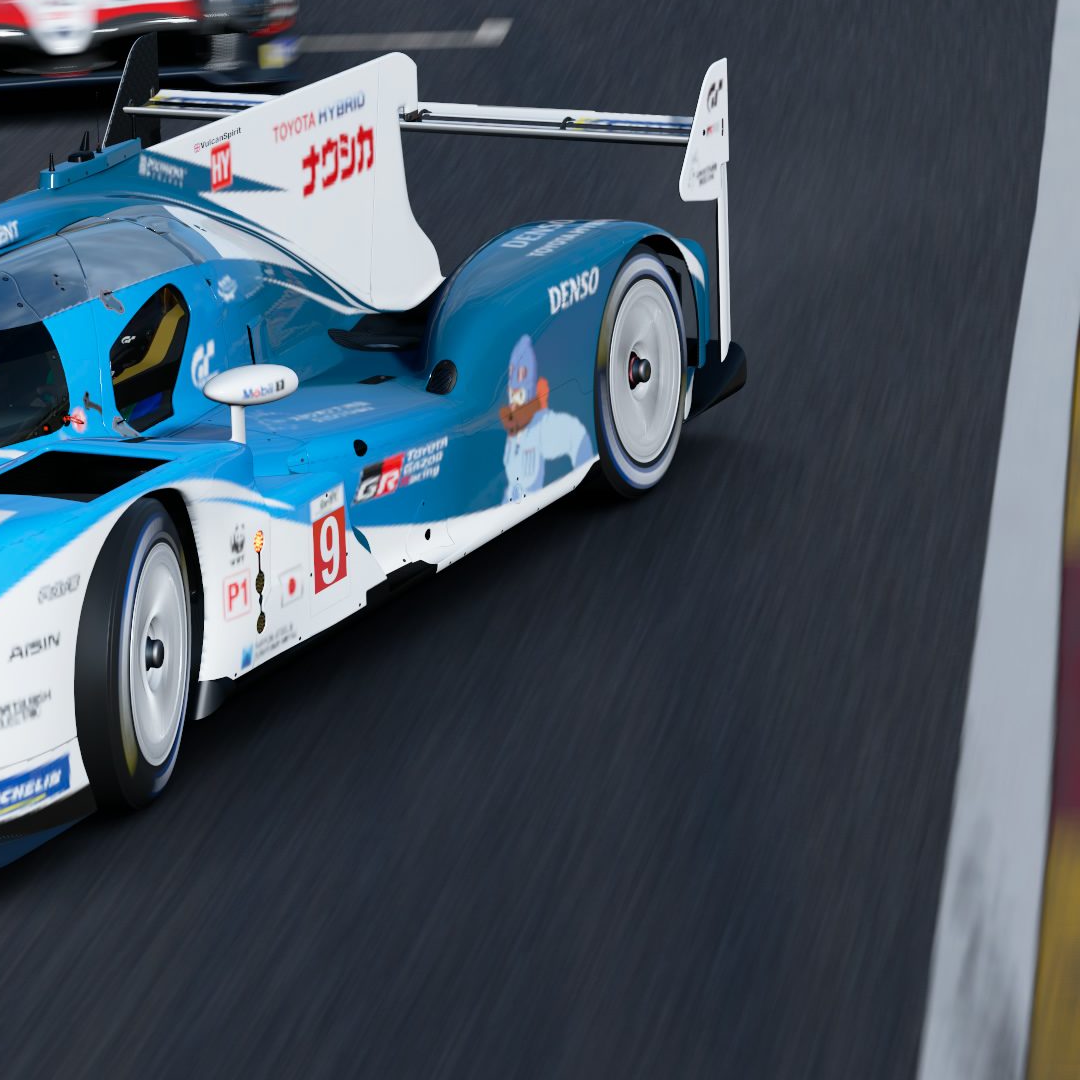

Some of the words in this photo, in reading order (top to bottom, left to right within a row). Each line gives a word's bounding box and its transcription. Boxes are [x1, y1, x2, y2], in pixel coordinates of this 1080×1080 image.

[273, 112, 316, 144] TOYOTA
[319, 93, 366, 124] HYBRID
[200, 127, 242, 149] VulcanSpirit
[212, 146, 232, 185] HY
[302, 124, 374, 197] ナウシカ
[548, 266, 600, 315] DENSO
[242, 384, 274, 399] Mobil
[403, 451, 443, 476] GAZOO
[357, 469, 400, 502] GR
[320, 515, 341, 585] 9
[228, 578, 248, 612] P1
[8, 631, 62, 662] AISIN
